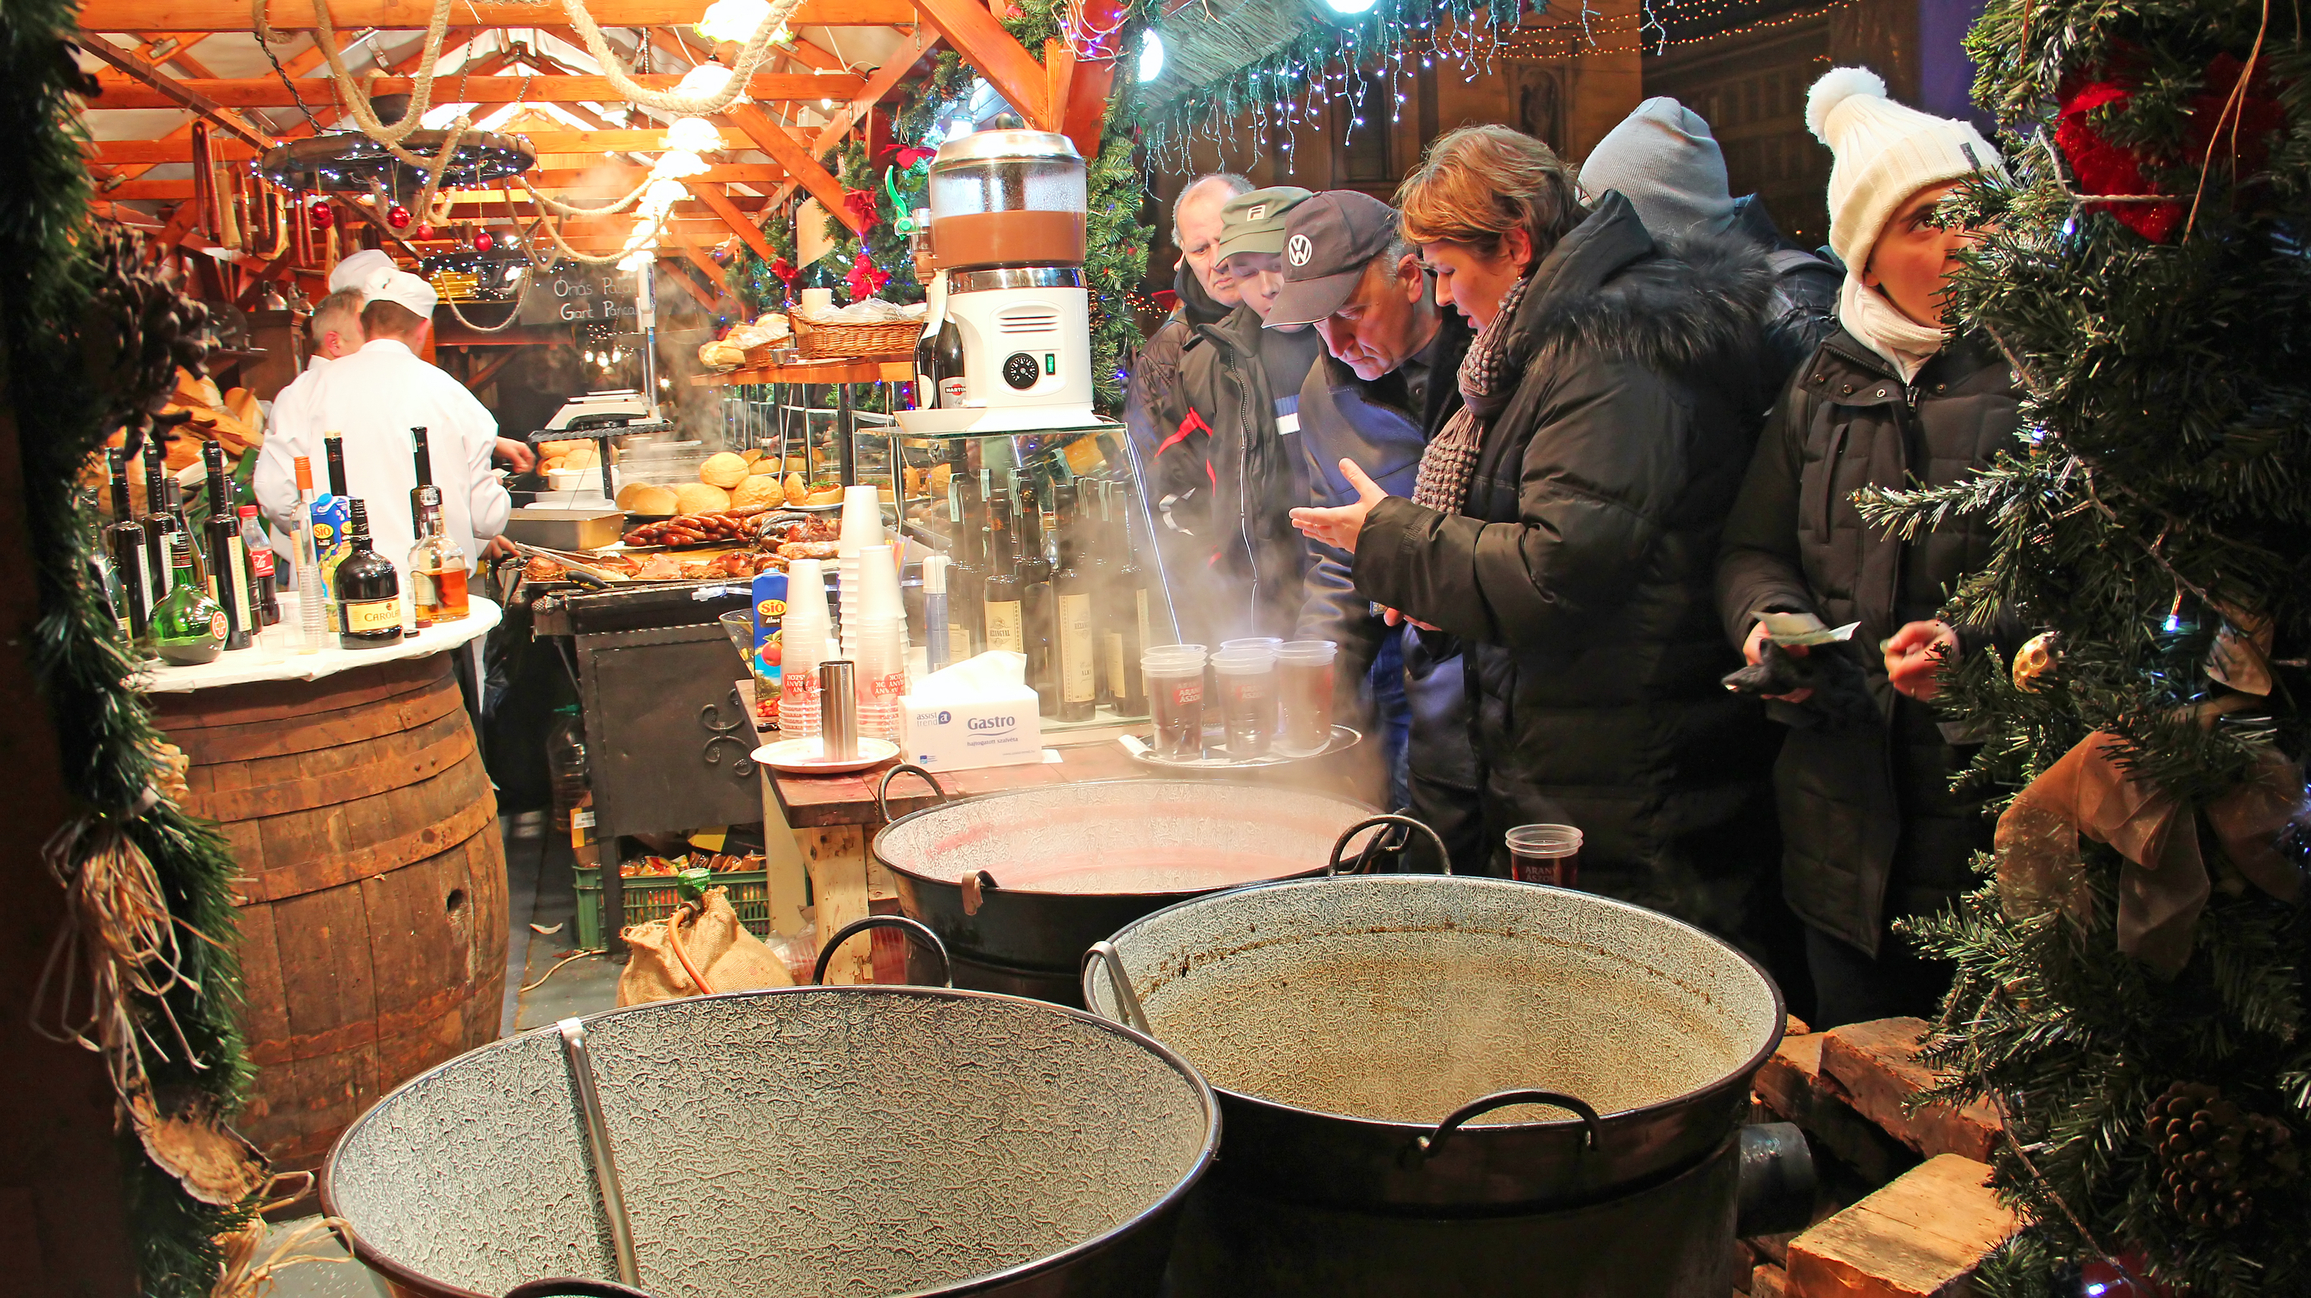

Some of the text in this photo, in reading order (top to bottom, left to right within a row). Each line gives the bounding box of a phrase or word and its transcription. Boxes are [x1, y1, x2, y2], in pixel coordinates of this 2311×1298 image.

[560, 300, 638, 320] Giant Panca
[917, 719, 938, 727] trend
[967, 716, 1015, 730] Gastro
